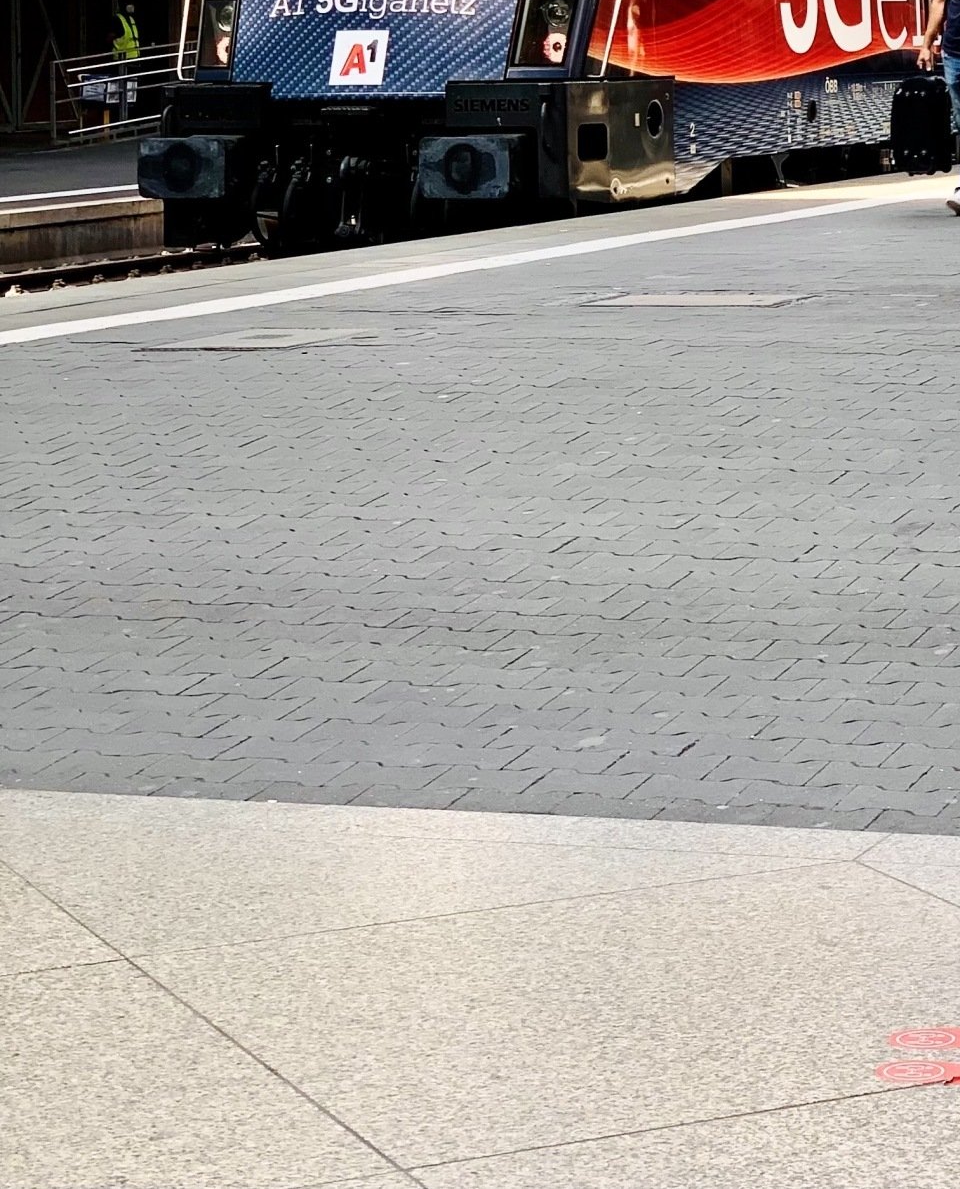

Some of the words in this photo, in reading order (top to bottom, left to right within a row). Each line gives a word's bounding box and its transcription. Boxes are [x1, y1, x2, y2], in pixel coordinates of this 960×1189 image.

[339, 39, 379, 77] A1
[824, 76, 839, 94] ÖBB
[454, 97, 530, 112] SIEMENS
